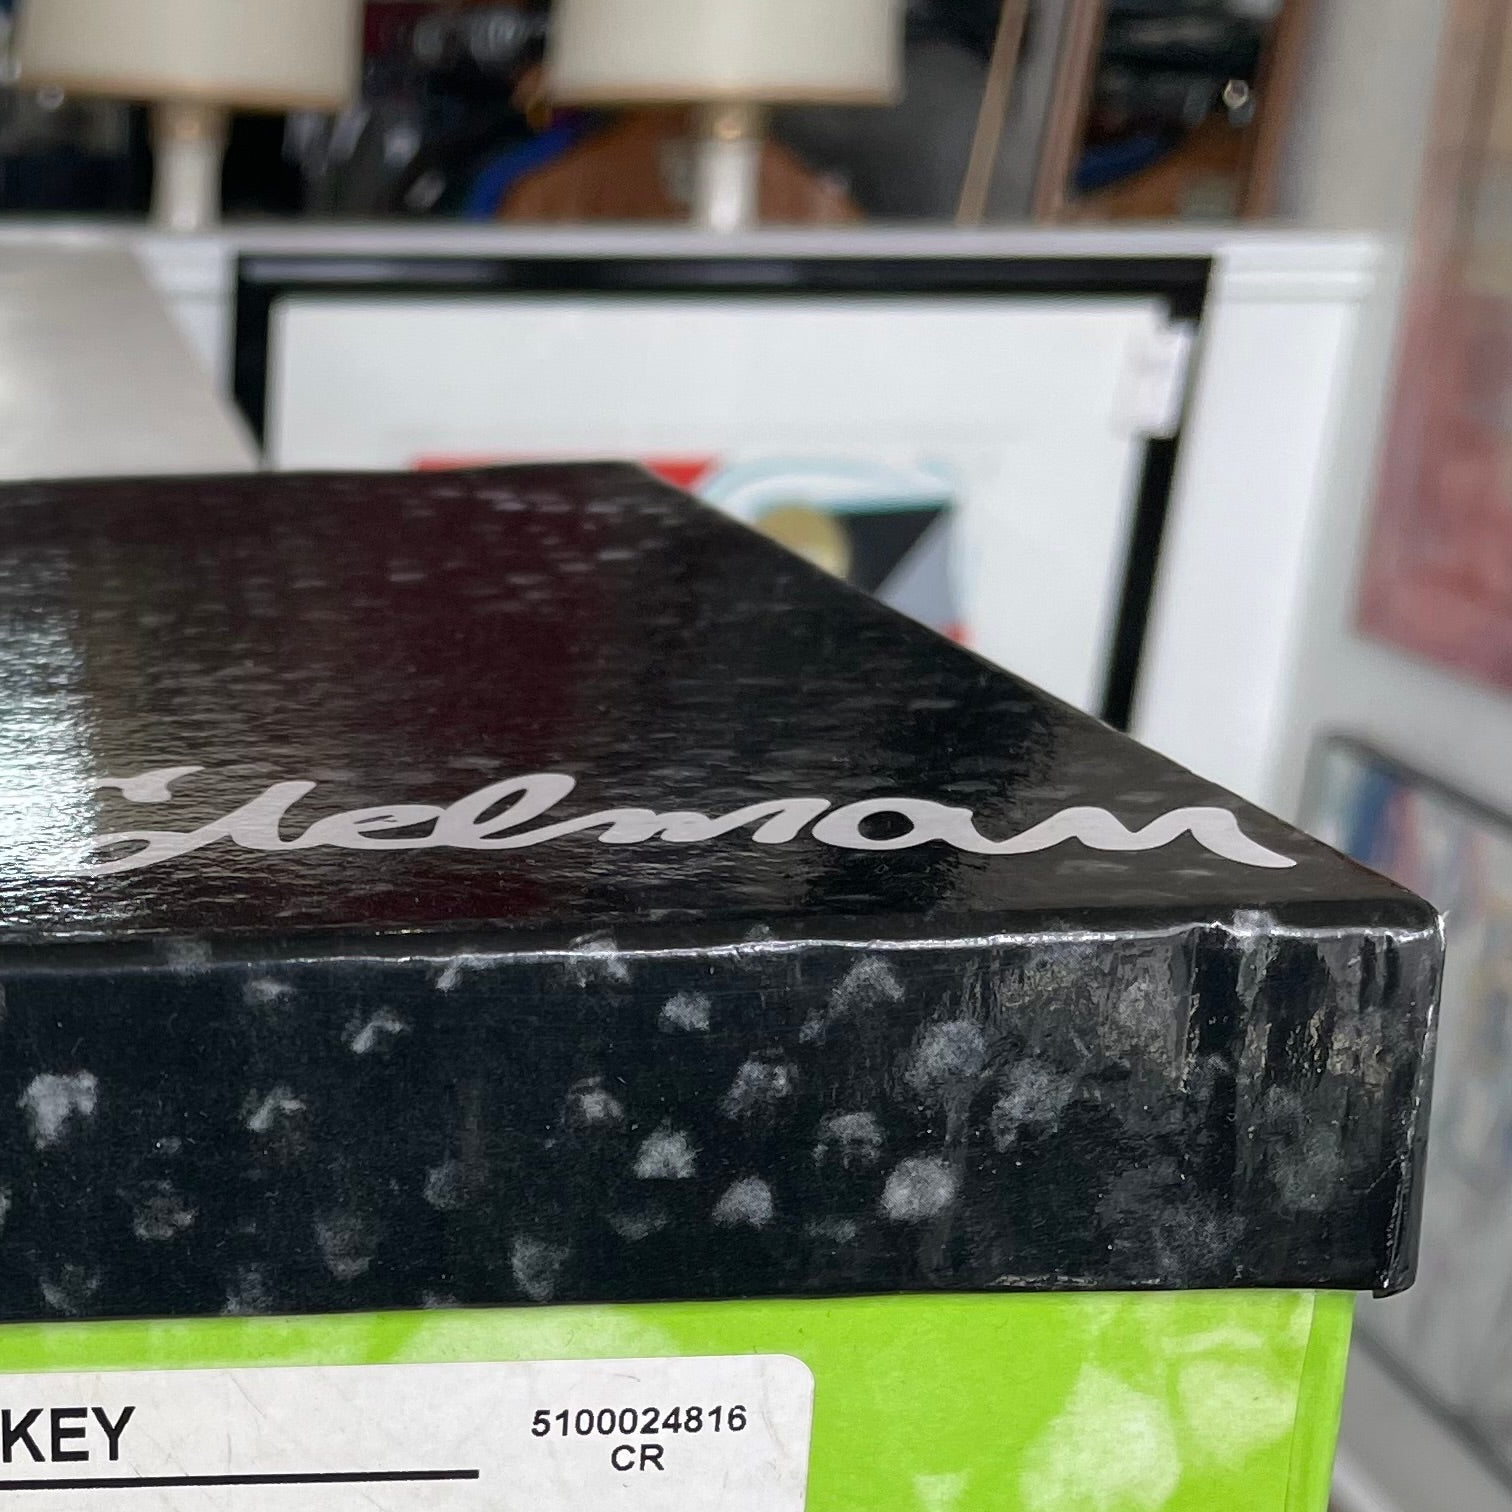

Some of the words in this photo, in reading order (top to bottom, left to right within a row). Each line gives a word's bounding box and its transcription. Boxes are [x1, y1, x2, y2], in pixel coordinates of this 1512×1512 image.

[80, 765, 1300, 880] delman
[531, 1405, 747, 1437] 5100024816
[611, 1443, 665, 1471] CR
